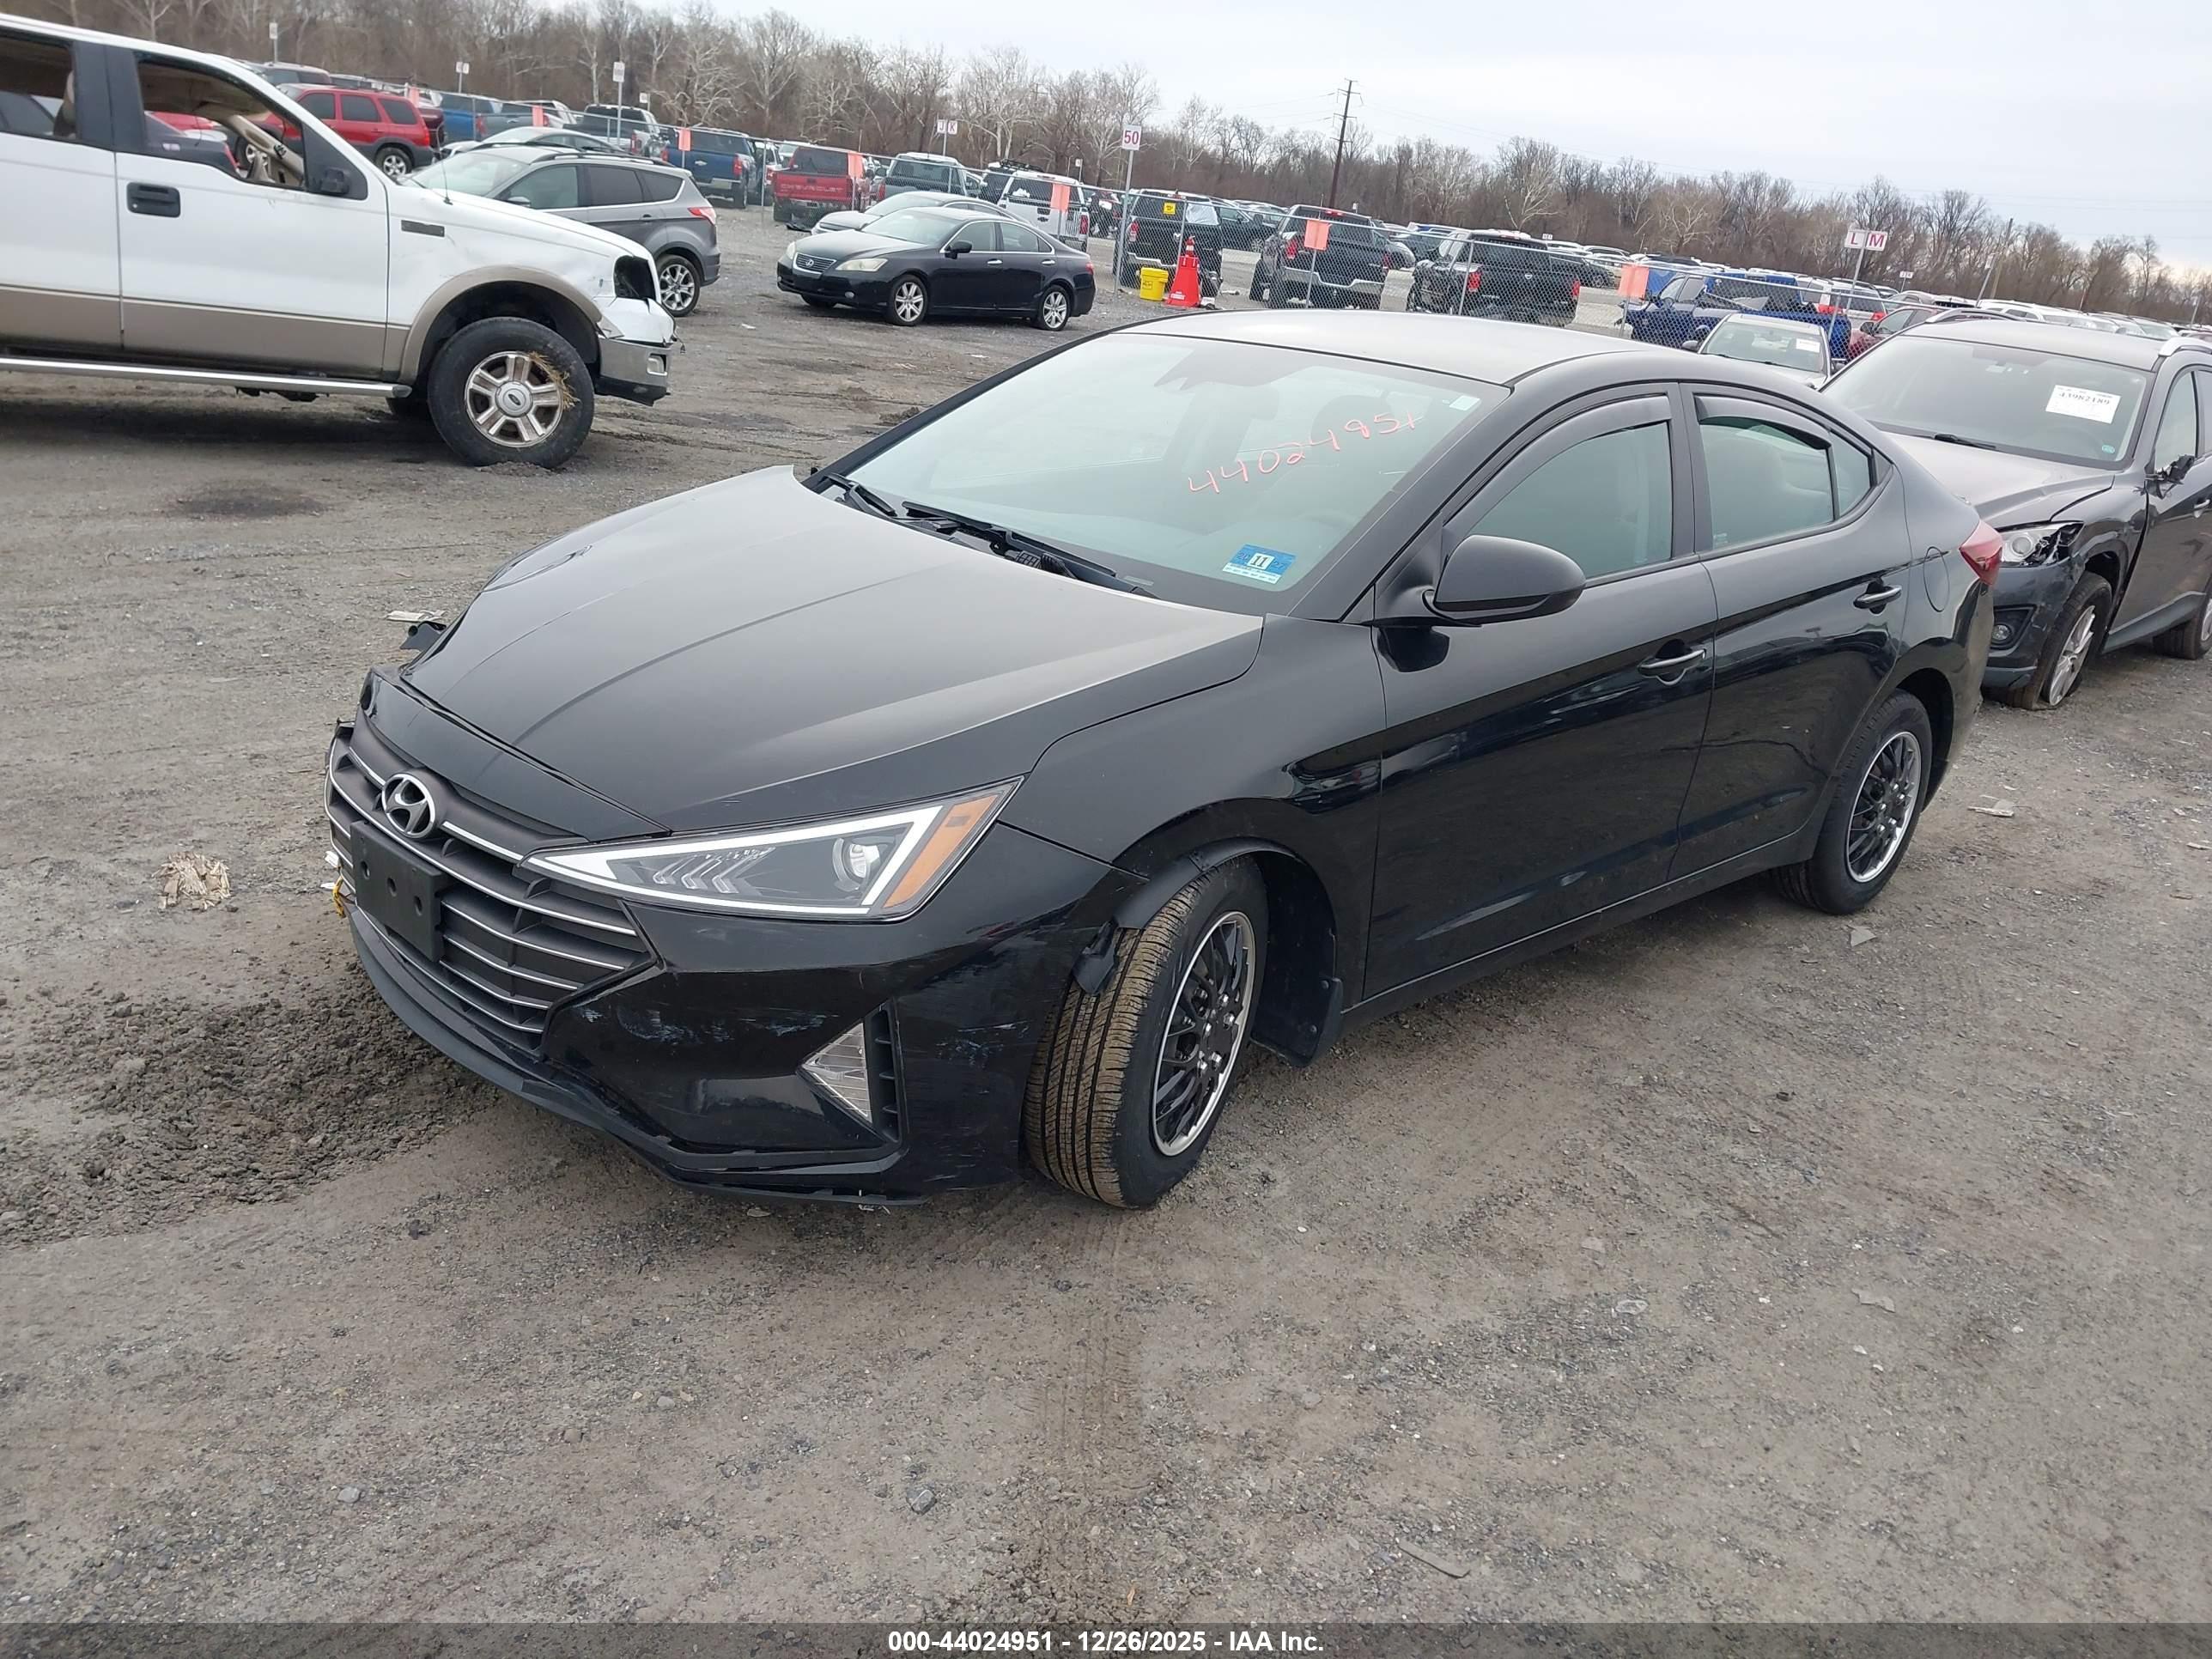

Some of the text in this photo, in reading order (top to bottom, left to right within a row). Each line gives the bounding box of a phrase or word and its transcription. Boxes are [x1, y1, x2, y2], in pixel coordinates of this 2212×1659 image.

[1124, 130, 1139, 145] 50
[1850, 233, 1885, 248] L M
[1188, 411, 1416, 494] 44024951
[1249, 555, 1268, 568] 11
